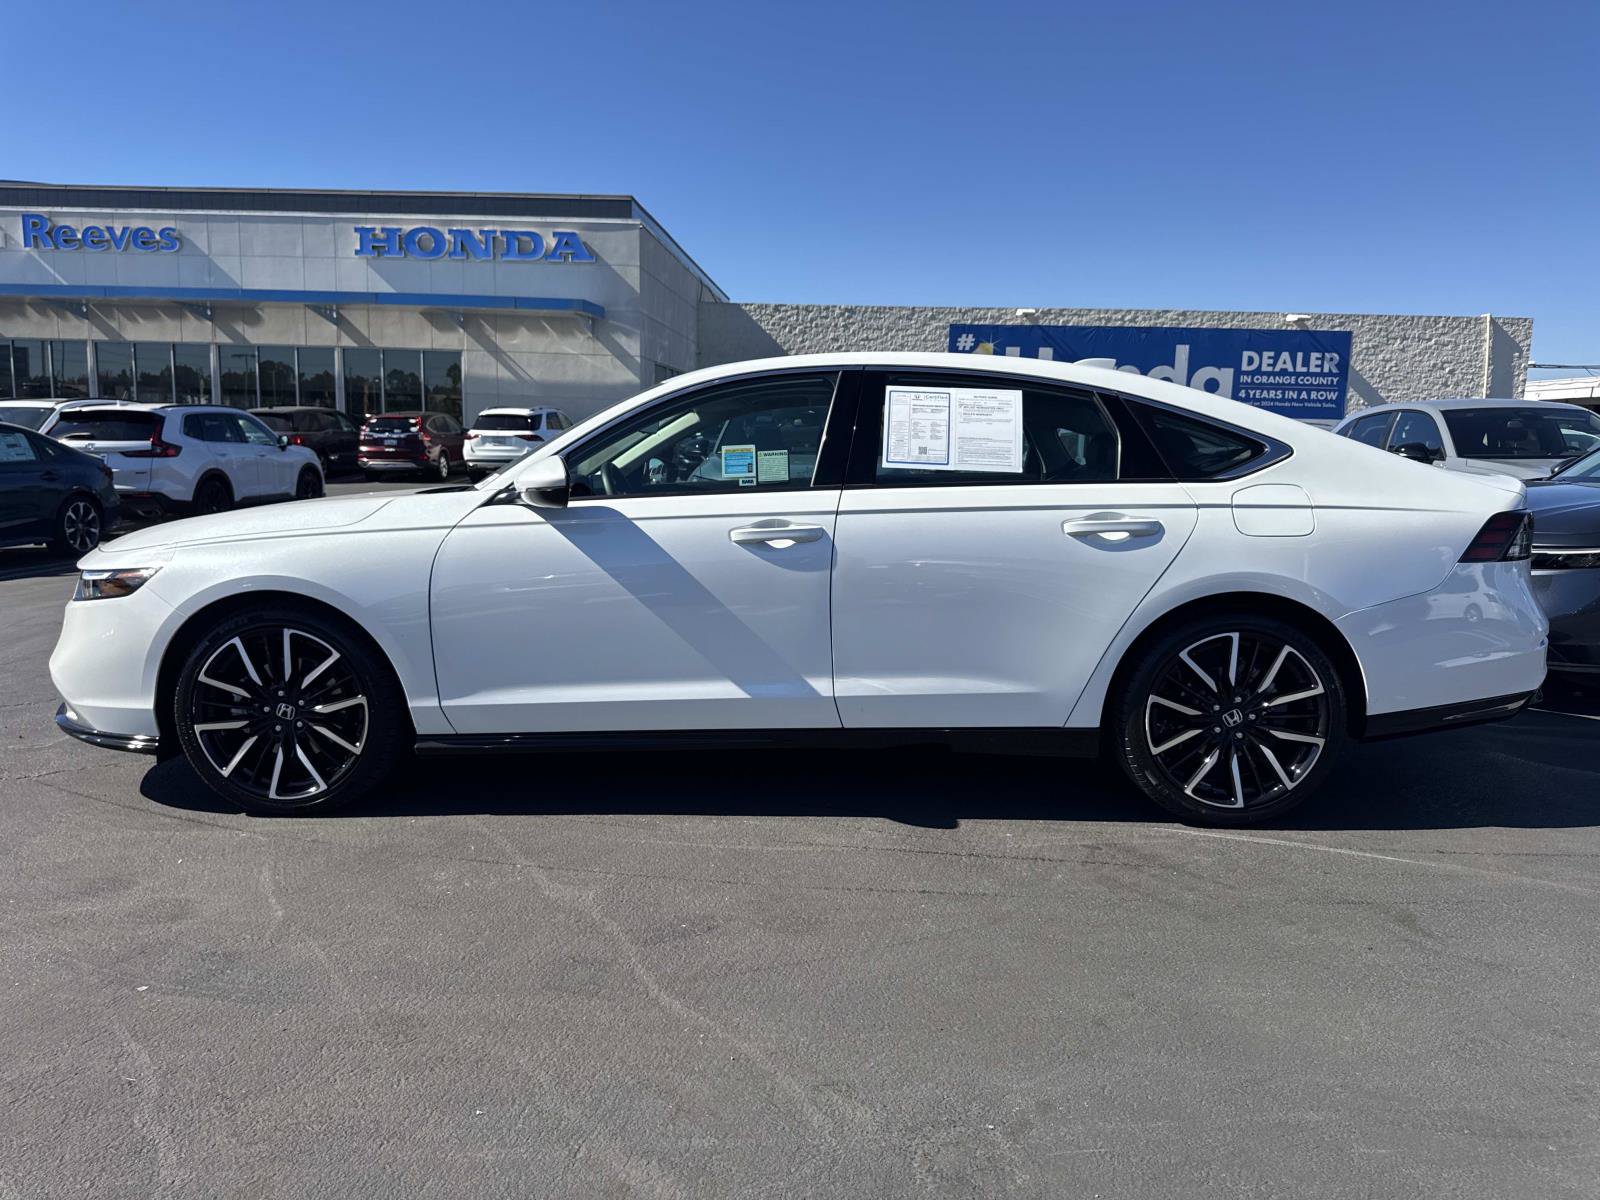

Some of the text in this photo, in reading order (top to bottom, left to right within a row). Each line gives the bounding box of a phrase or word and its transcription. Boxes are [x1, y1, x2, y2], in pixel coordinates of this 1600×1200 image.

[21, 213, 180, 252] Reeves
[354, 226, 596, 263] HONDA
[1241, 350, 1340, 373] DEALER
[1240, 375, 1339, 385] IN ORANGE COUNTY
[1238, 389, 1339, 400] 4 YEARS IN A ROW
